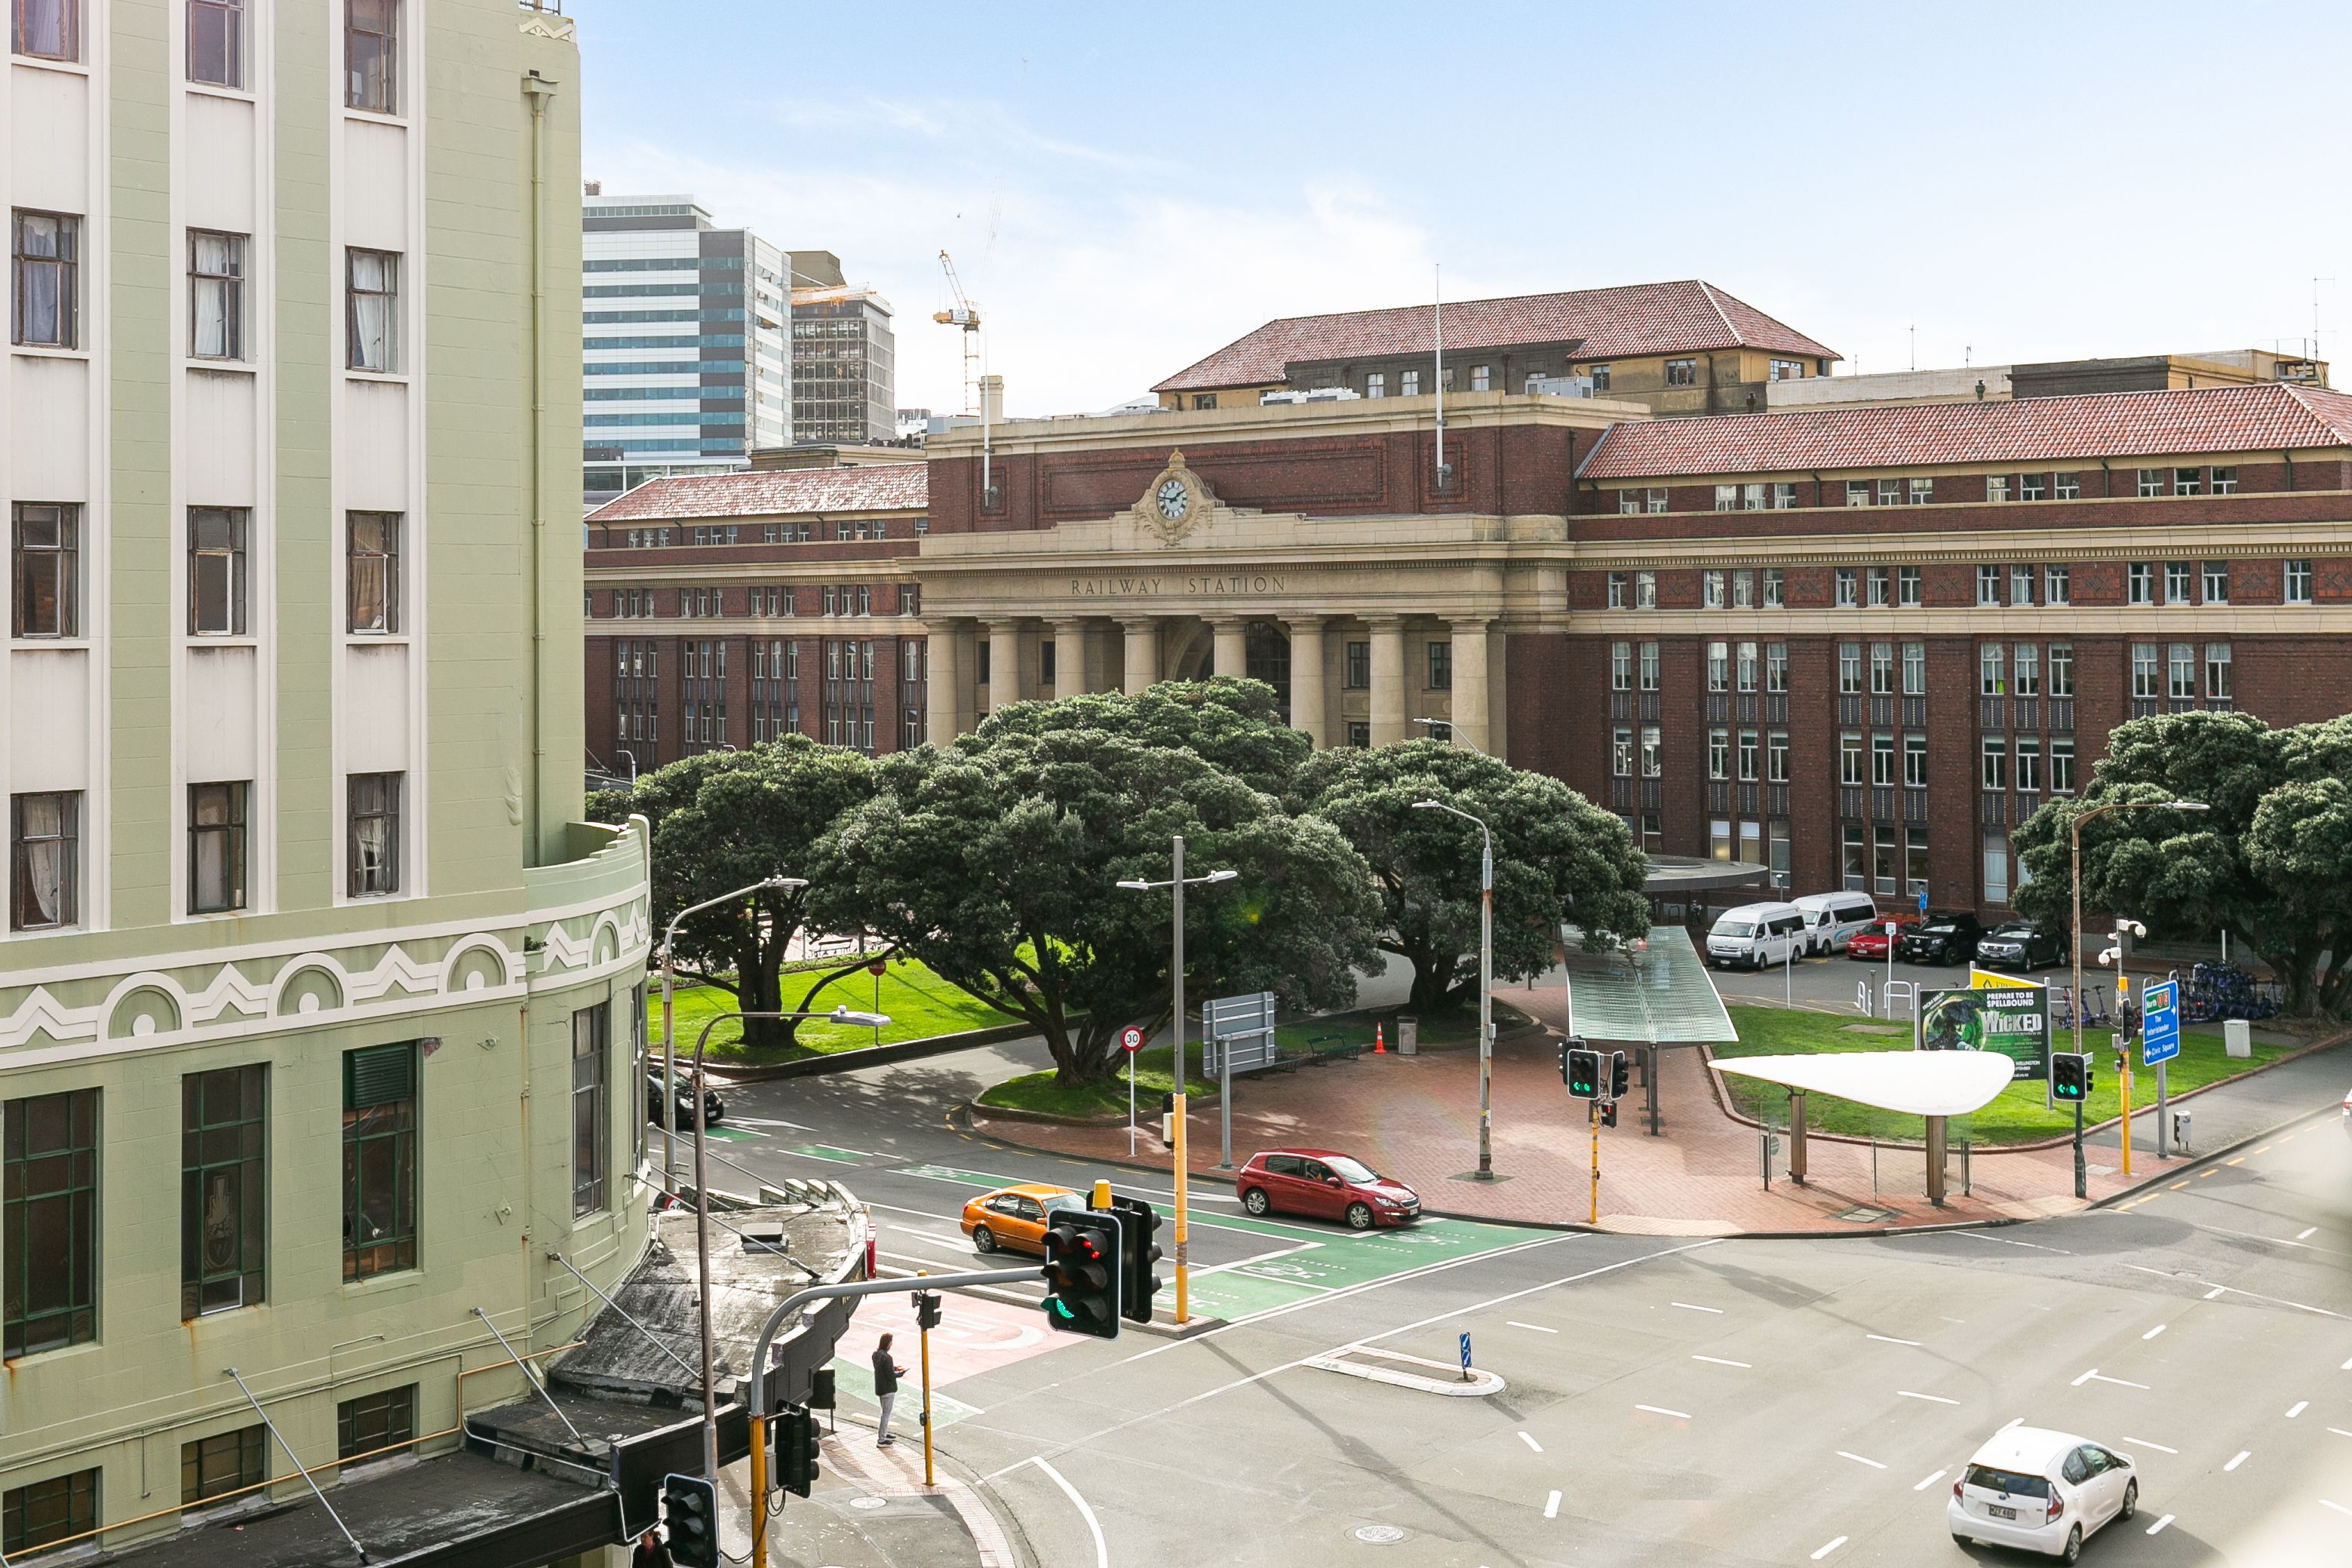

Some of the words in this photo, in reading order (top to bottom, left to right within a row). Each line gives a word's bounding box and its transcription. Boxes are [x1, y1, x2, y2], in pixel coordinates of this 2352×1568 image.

[1072, 578, 1162, 595] RAILWAY
[1189, 576, 1285, 593] STATION
[1987, 999, 2034, 1008] SPELLBOUND
[2146, 999, 2157, 1008] North
[1127, 1034, 1138, 1043] 30
[2152, 1048, 2160, 1056] Civic
[2162, 1043, 2174, 1053] Square
